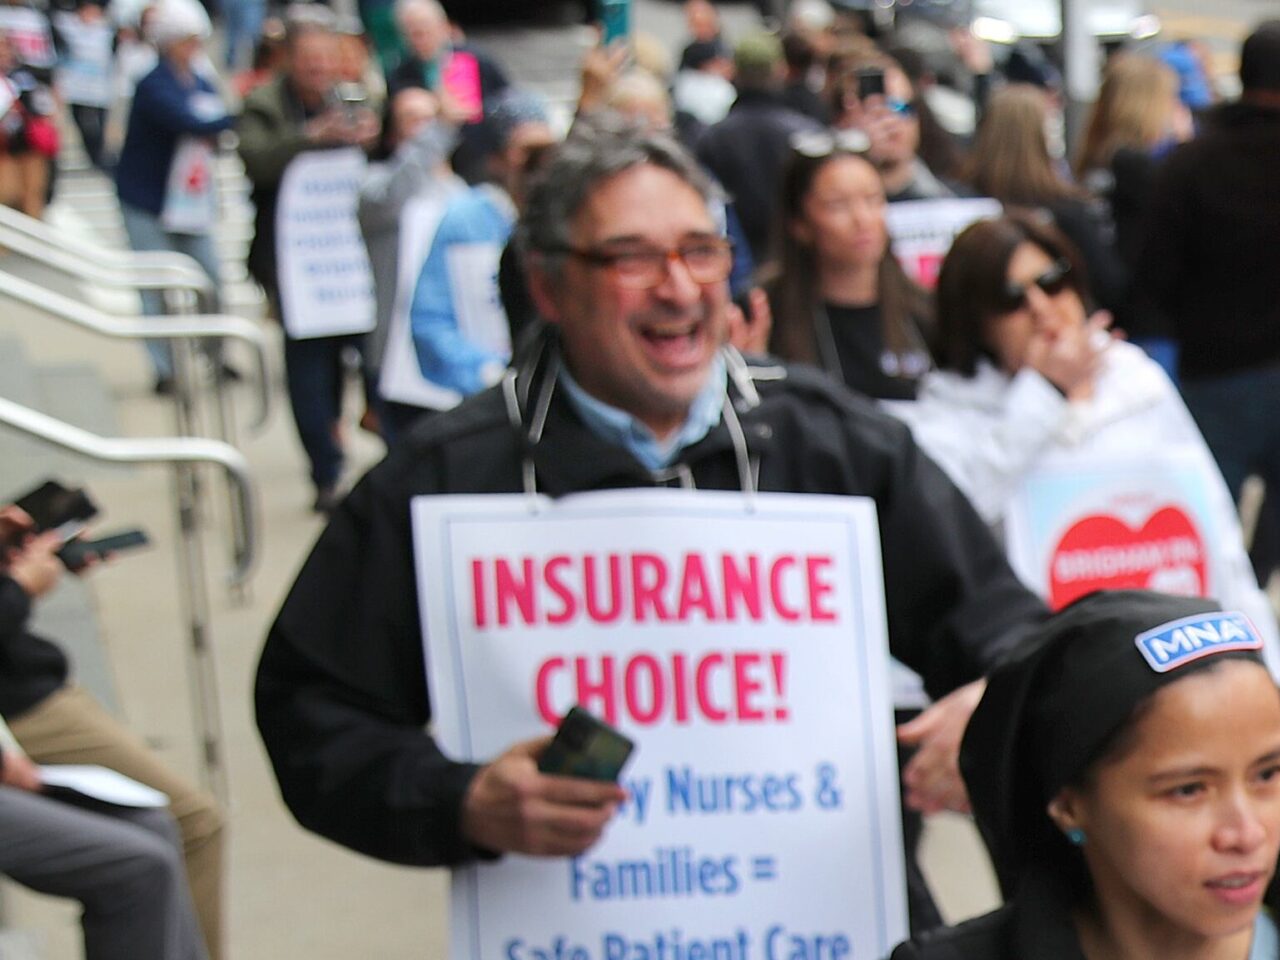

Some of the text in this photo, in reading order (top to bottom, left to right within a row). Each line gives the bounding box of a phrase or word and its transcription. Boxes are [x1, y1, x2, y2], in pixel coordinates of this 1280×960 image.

[472, 553, 836, 628] INSURANCE
[1150, 619, 1249, 662] MNA
[535, 653, 788, 726] CHOICE!
[665, 764, 802, 812] Nurses
[815, 761, 843, 809] &
[570, 846, 740, 901] Families
